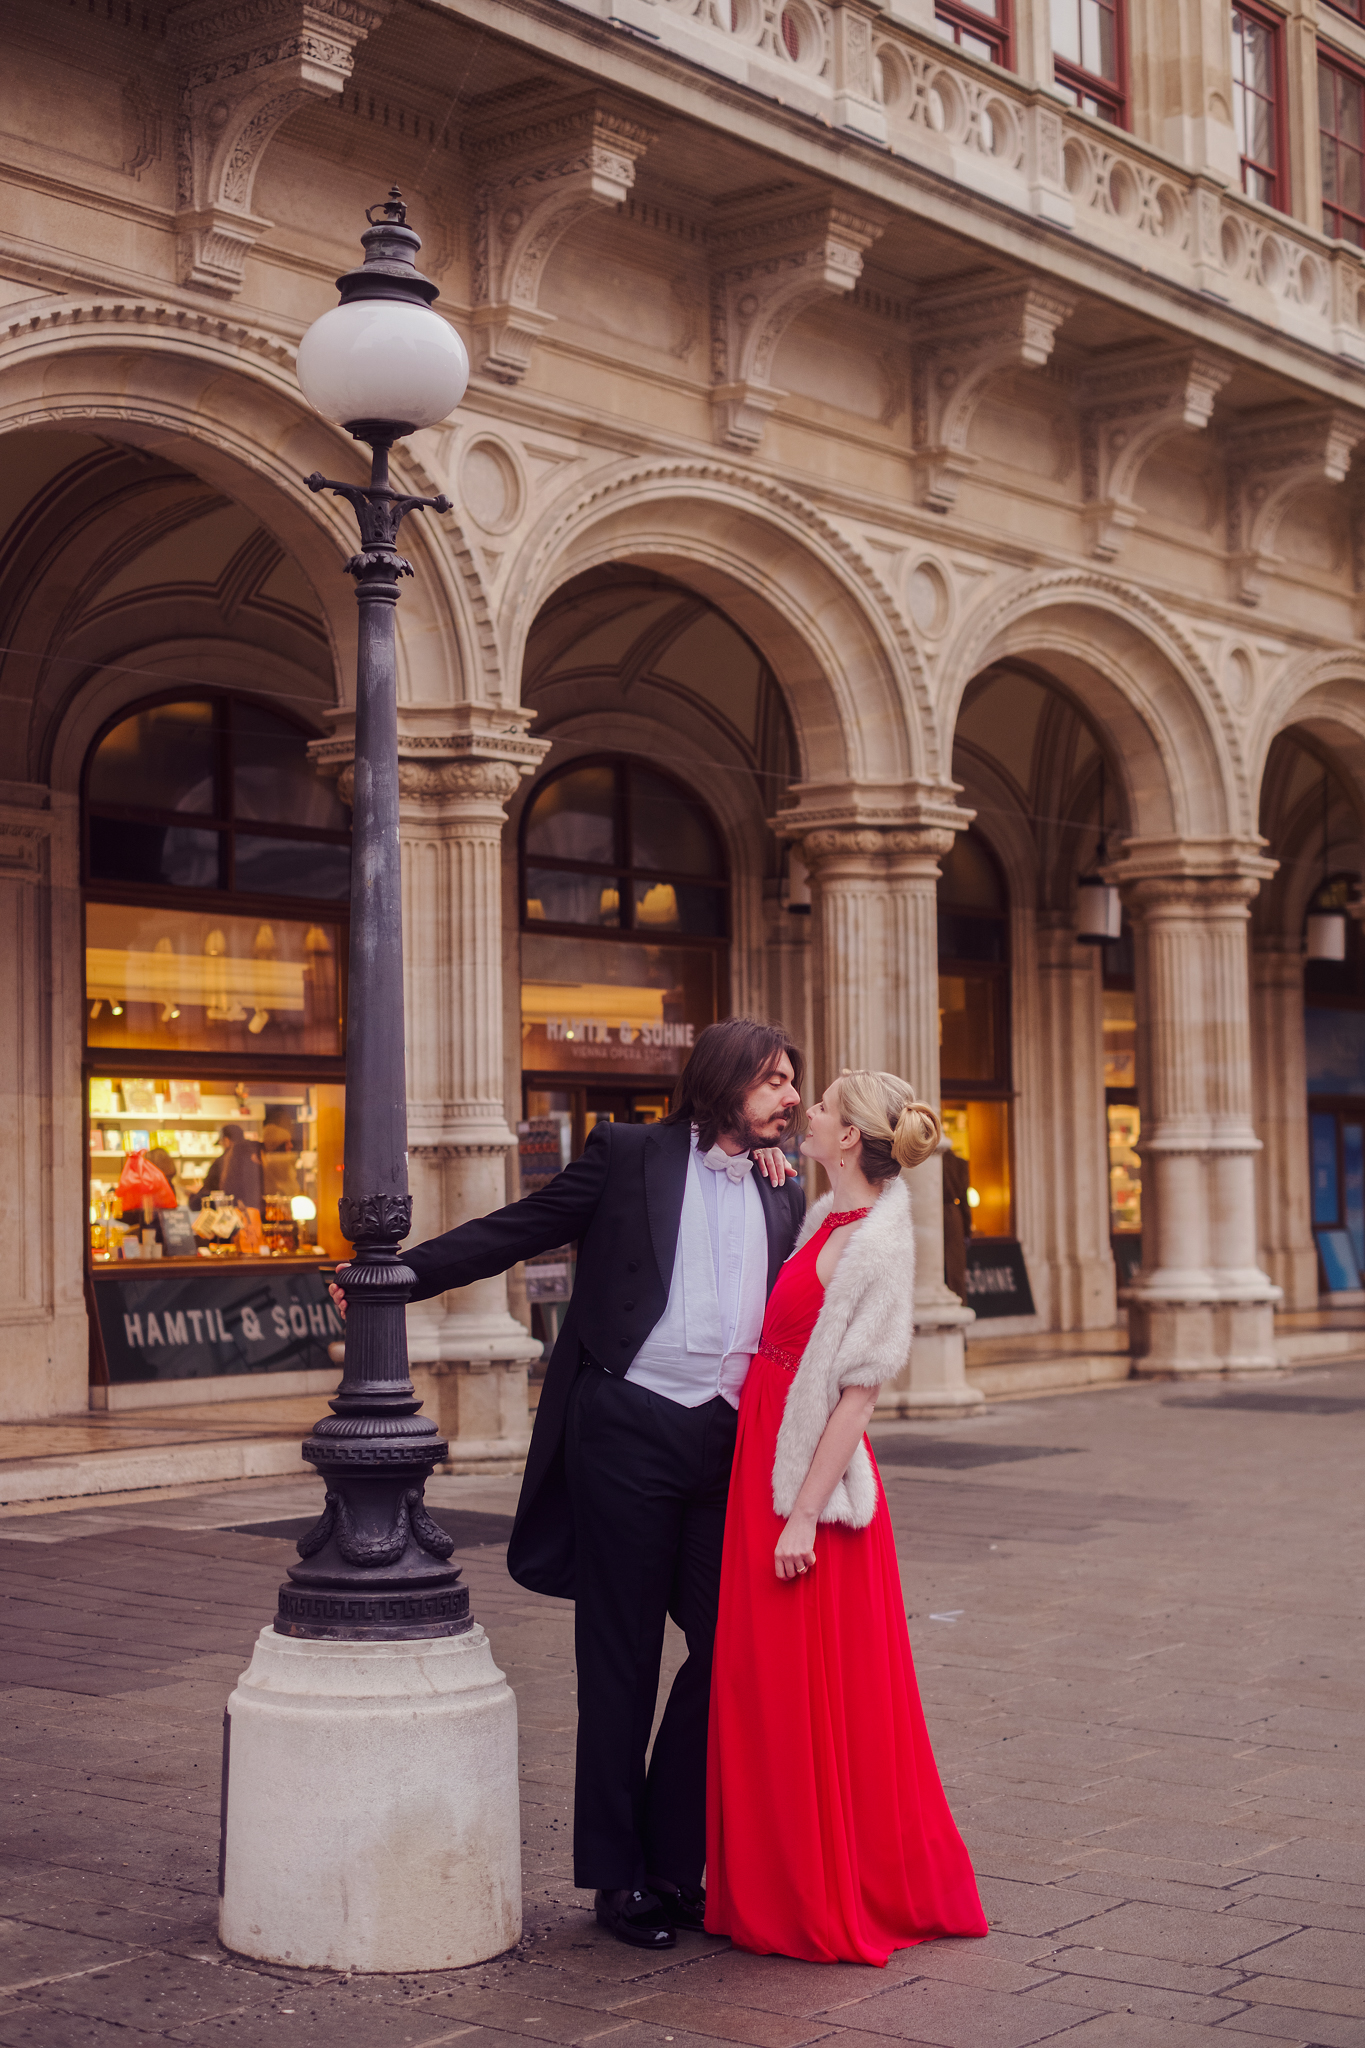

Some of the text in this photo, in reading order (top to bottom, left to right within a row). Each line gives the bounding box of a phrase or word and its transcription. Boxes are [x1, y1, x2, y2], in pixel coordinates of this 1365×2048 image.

[546, 1017, 612, 1044] HAMTIL
[619, 1021, 634, 1045] &
[123, 1296, 344, 1348] HAMTIL & SÖHN
